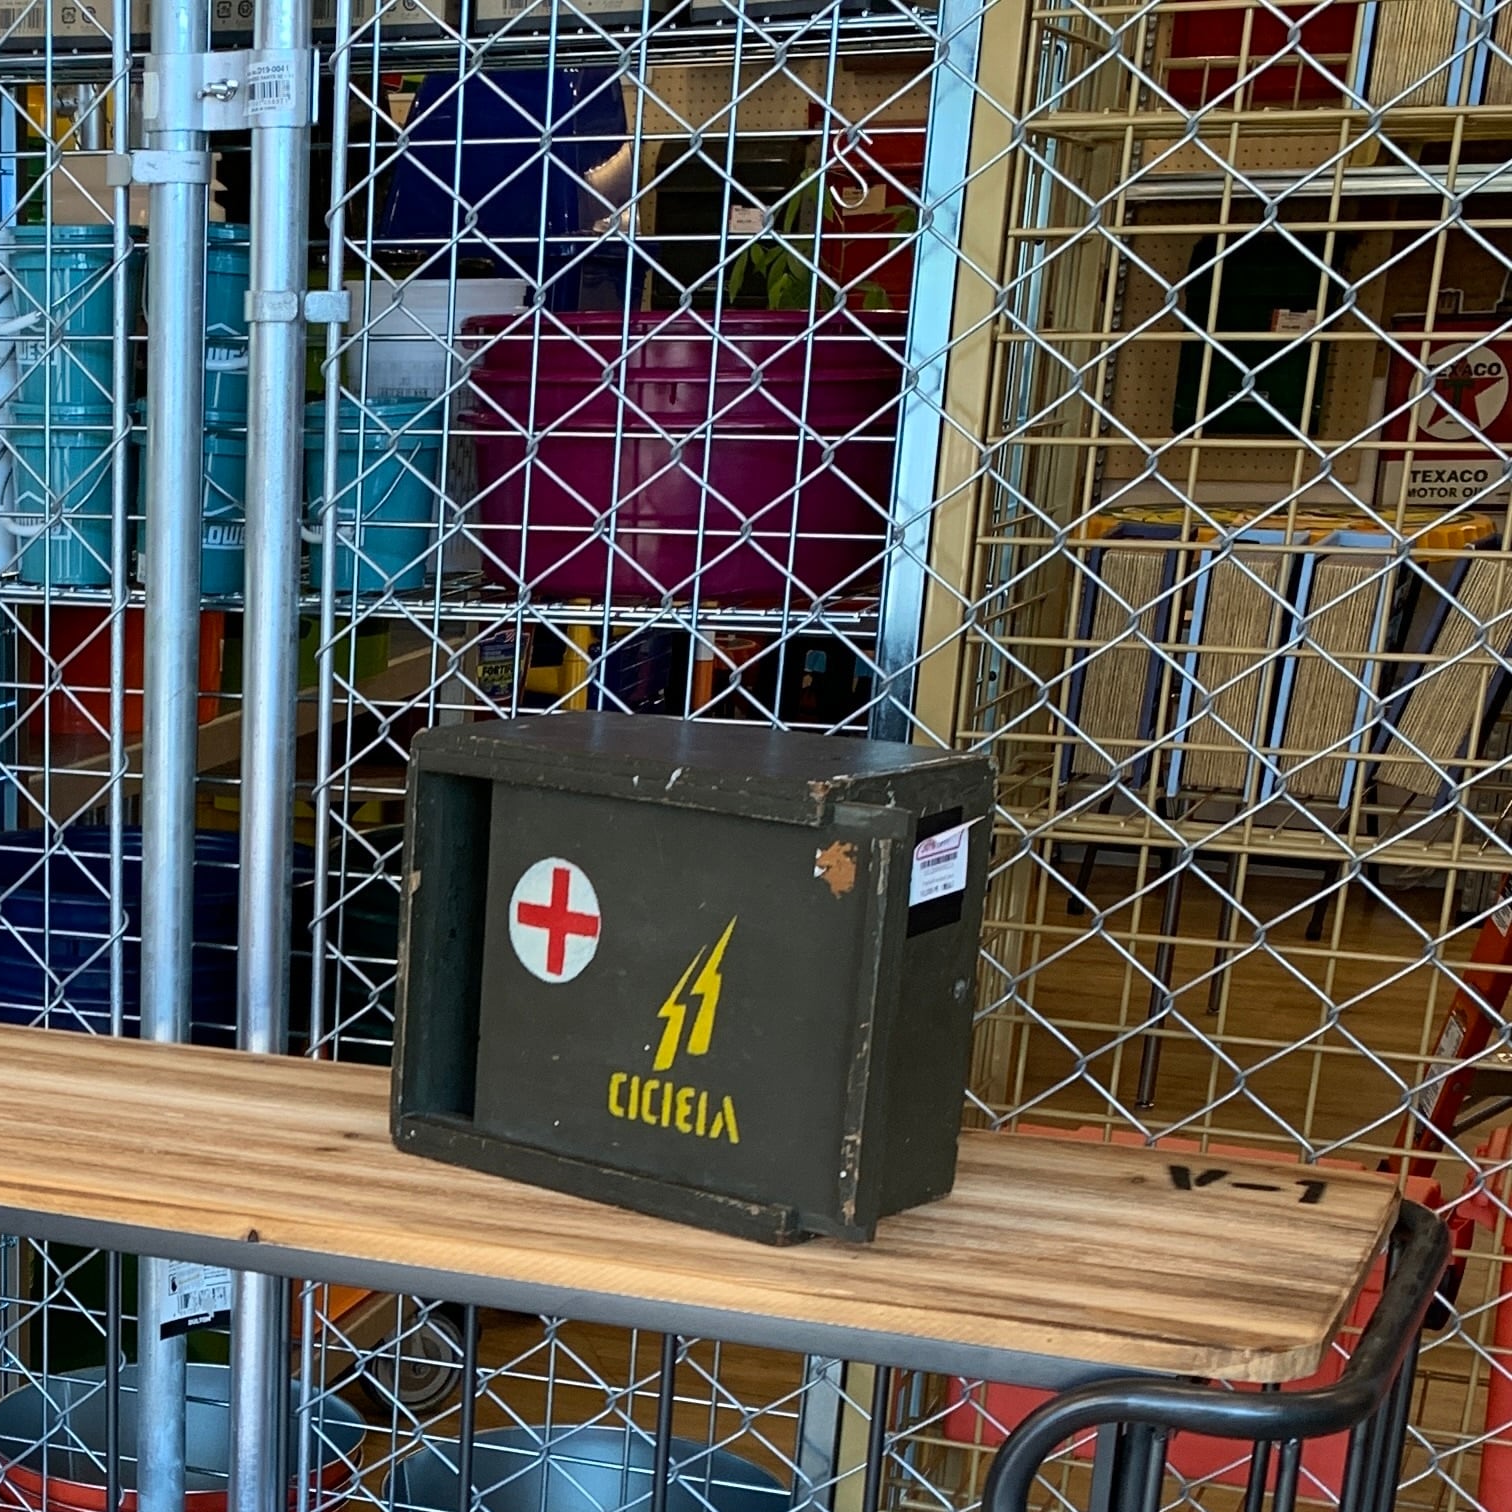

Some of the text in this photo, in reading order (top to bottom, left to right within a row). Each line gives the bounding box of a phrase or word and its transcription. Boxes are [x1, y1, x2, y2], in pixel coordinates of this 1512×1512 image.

[1410, 469, 1489, 484] TEXACO
[1407, 487, 1458, 499] MOTOR
[1168, 1164, 1328, 1205] V-1
